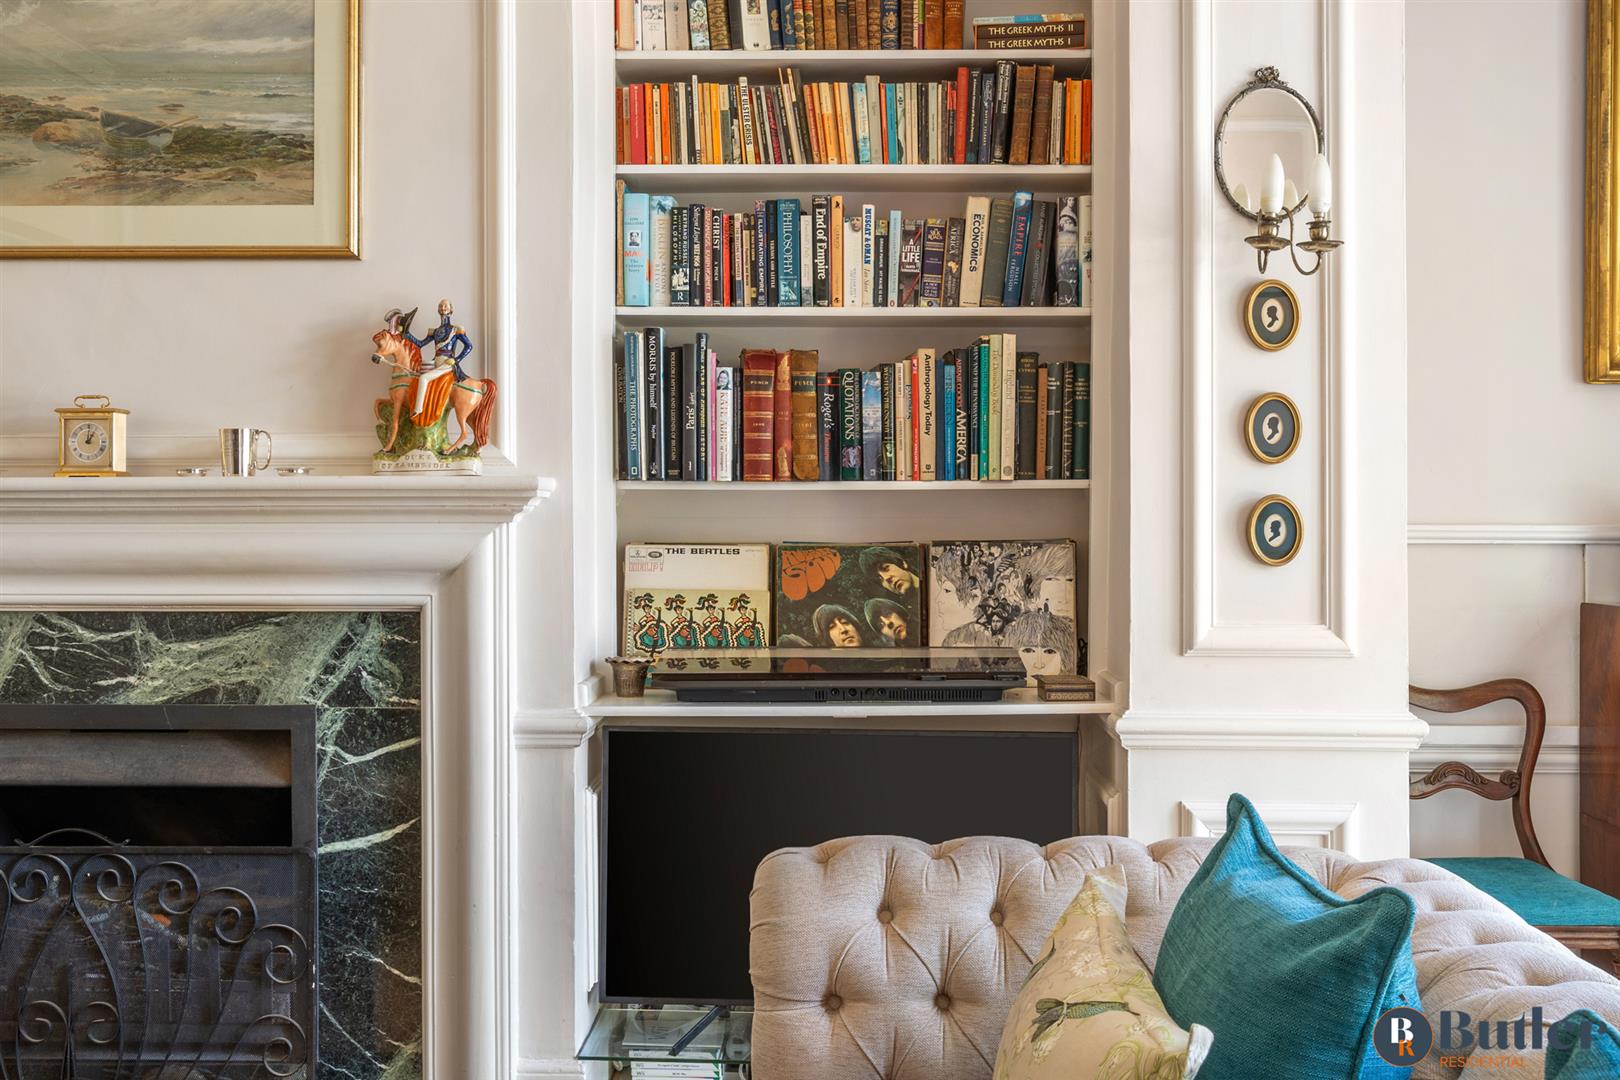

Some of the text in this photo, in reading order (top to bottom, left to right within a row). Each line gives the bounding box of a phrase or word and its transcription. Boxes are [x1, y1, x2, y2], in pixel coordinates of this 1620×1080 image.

[988, 24, 1074, 36] THE GREEK MYTHS II
[988, 40, 1006, 48] THE
[1007, 39, 1032, 48] GREEK
[1033, 37, 1064, 47] MYTHS
[742, 98, 751, 122] ULSTER
[658, 218, 667, 260] BERLIN
[783, 212, 792, 274] PHILOSOPHY
[816, 208, 828, 280] End of Empire
[969, 214, 982, 272] ECONOMICS
[1015, 216, 1026, 256] EMPIRE
[902, 252, 920, 262] LIFE
[1008, 259, 1016, 292] FERGUSON
[648, 373, 656, 382] by
[700, 389, 705, 397] OF
[1006, 370, 1014, 400] England
[720, 392, 728, 416] KATE
[822, 392, 834, 428] Roget's
[842, 371, 855, 440] QUOTATIONS
[923, 354, 932, 436] Anthropology Today
[720, 420, 728, 443] ADIE
[956, 409, 967, 464] AMERICA
